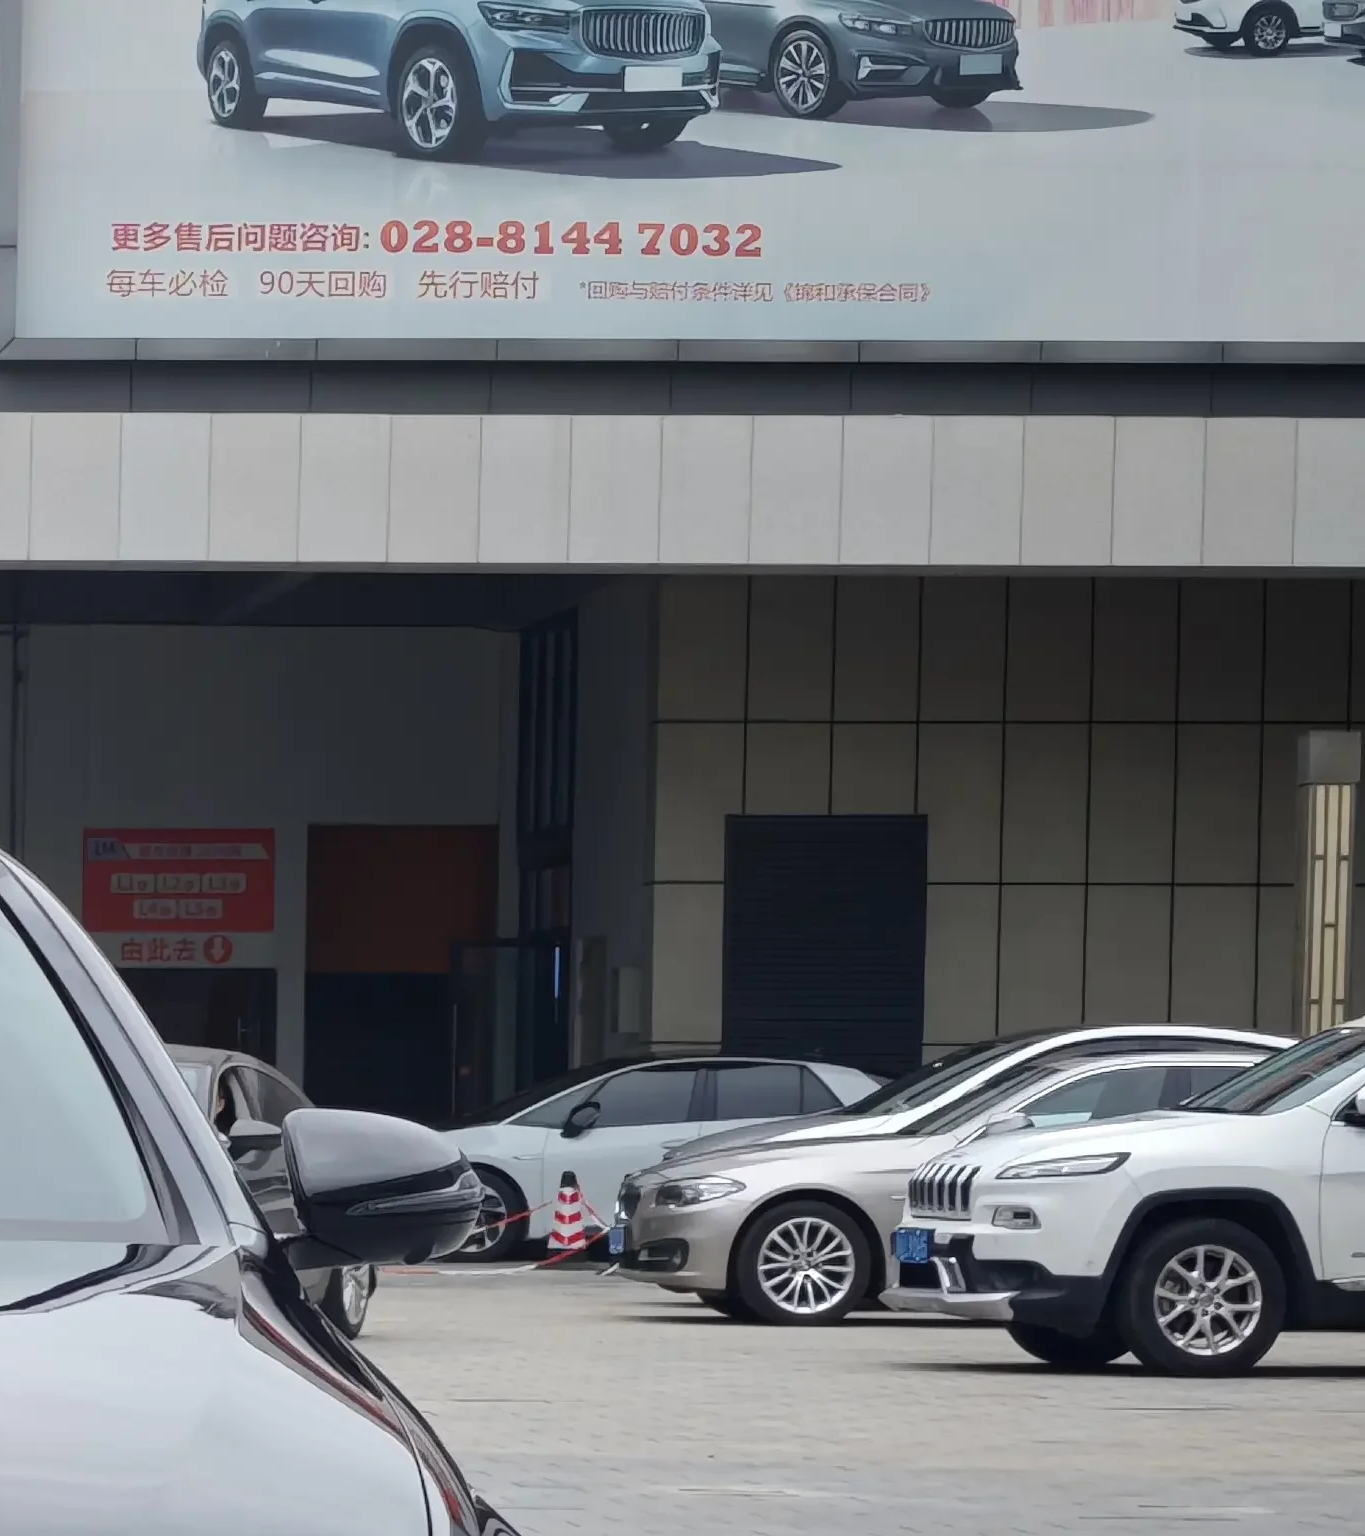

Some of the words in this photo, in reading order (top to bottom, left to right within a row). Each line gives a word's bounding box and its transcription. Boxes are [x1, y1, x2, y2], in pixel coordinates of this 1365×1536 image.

[110, 221, 371, 252] 更多售后问题咨询:
[380, 219, 623, 256] 028-8144
[637, 222, 763, 258] 7032
[106, 268, 229, 299] 每车必检
[259, 269, 387, 299] 90天回购
[416, 269, 540, 300] 先行赔付
[121, 938, 197, 963] 由此去
